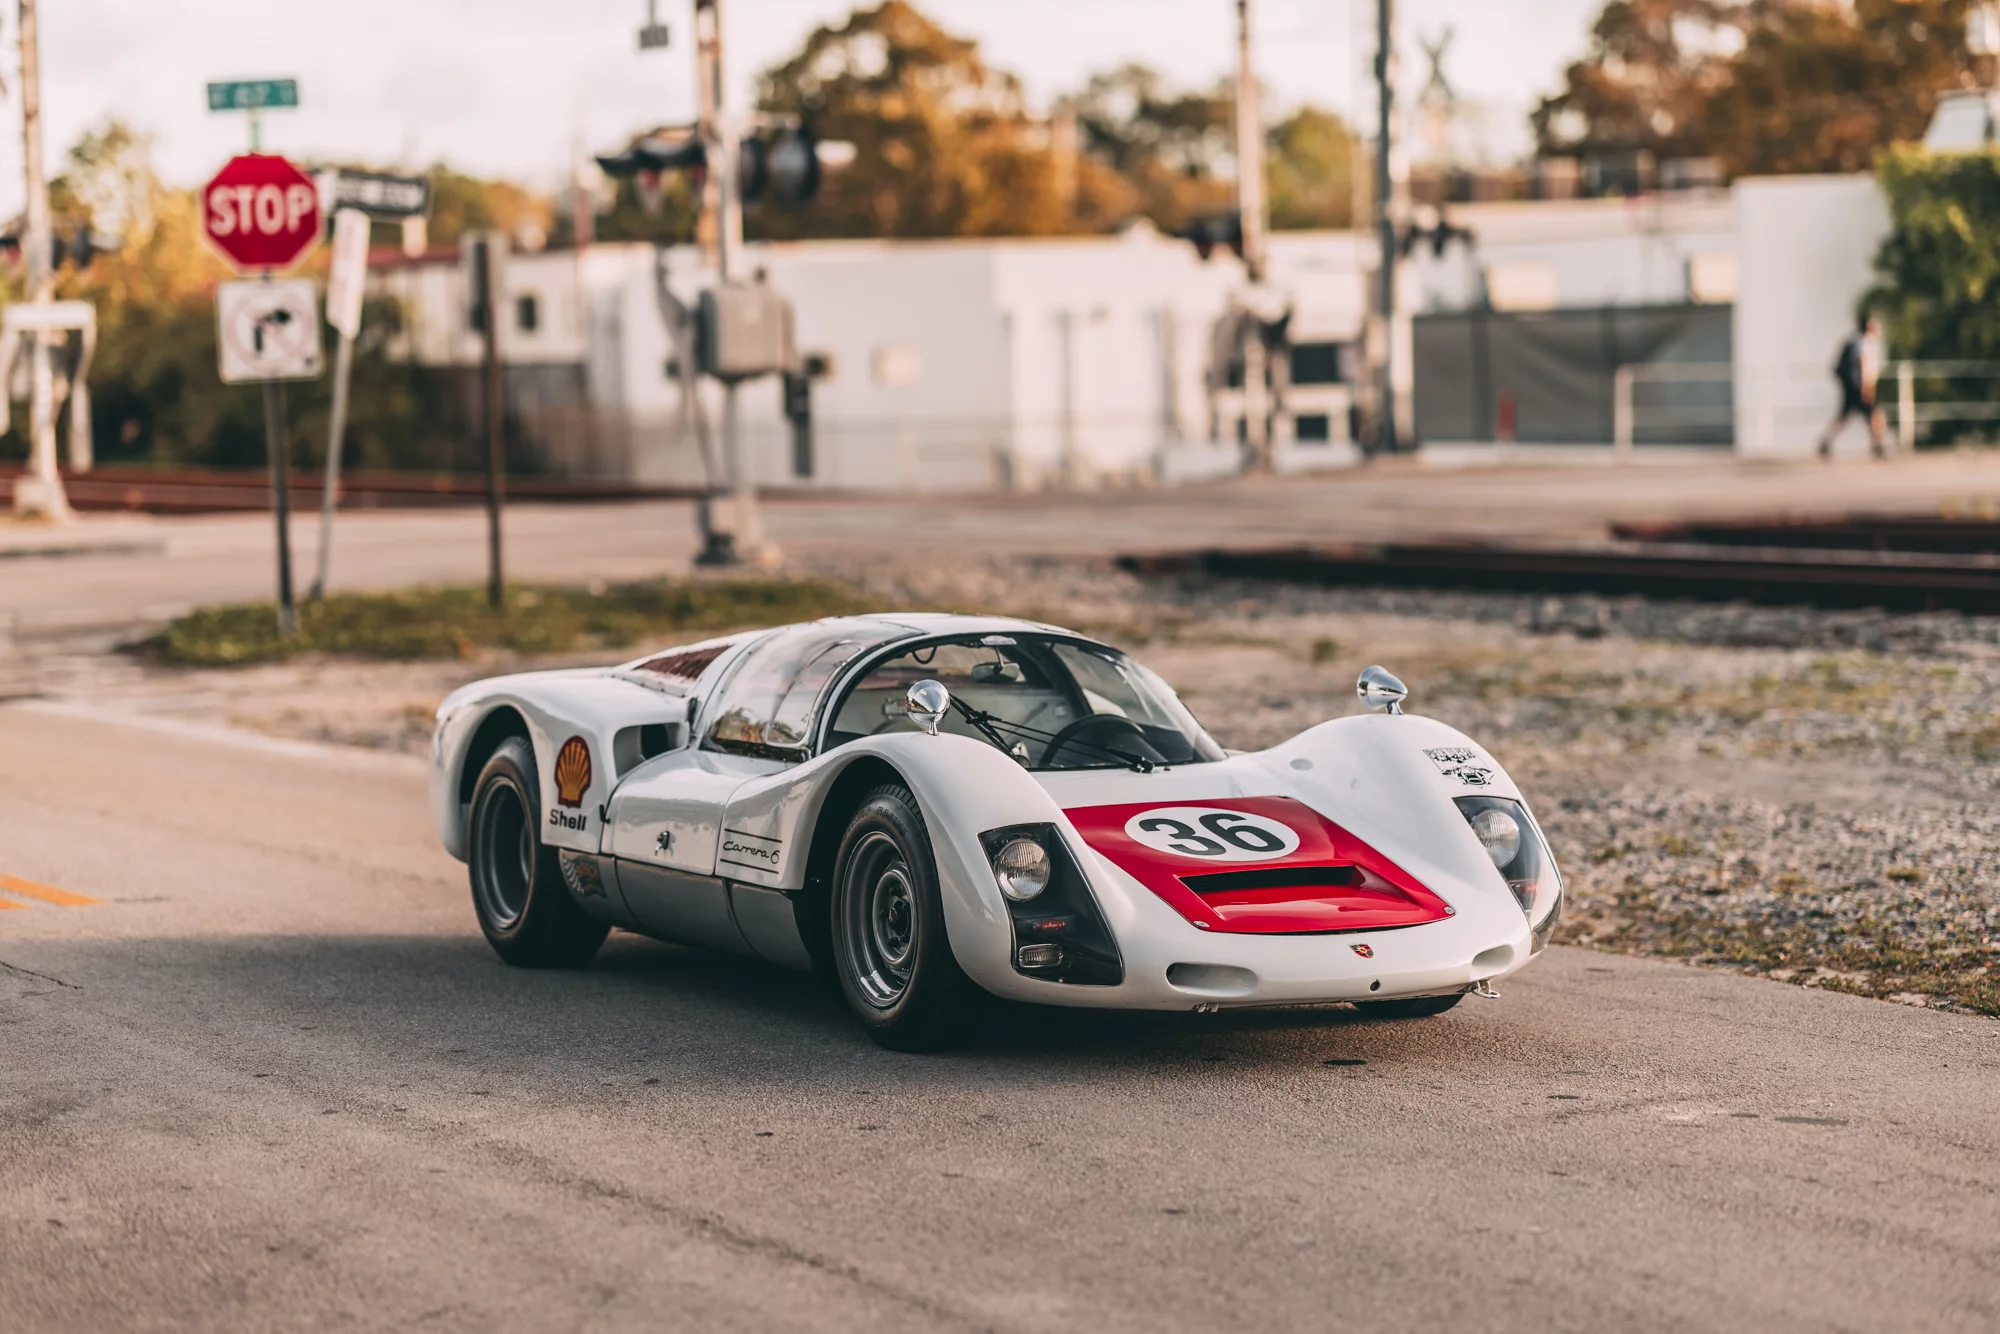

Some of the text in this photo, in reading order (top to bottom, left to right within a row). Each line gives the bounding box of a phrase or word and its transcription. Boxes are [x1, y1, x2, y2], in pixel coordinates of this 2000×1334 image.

[208, 183, 315, 236] STOP
[549, 809, 588, 831] Shell
[1138, 813, 1286, 856] 36
[722, 840, 781, 865] Carrera 6
